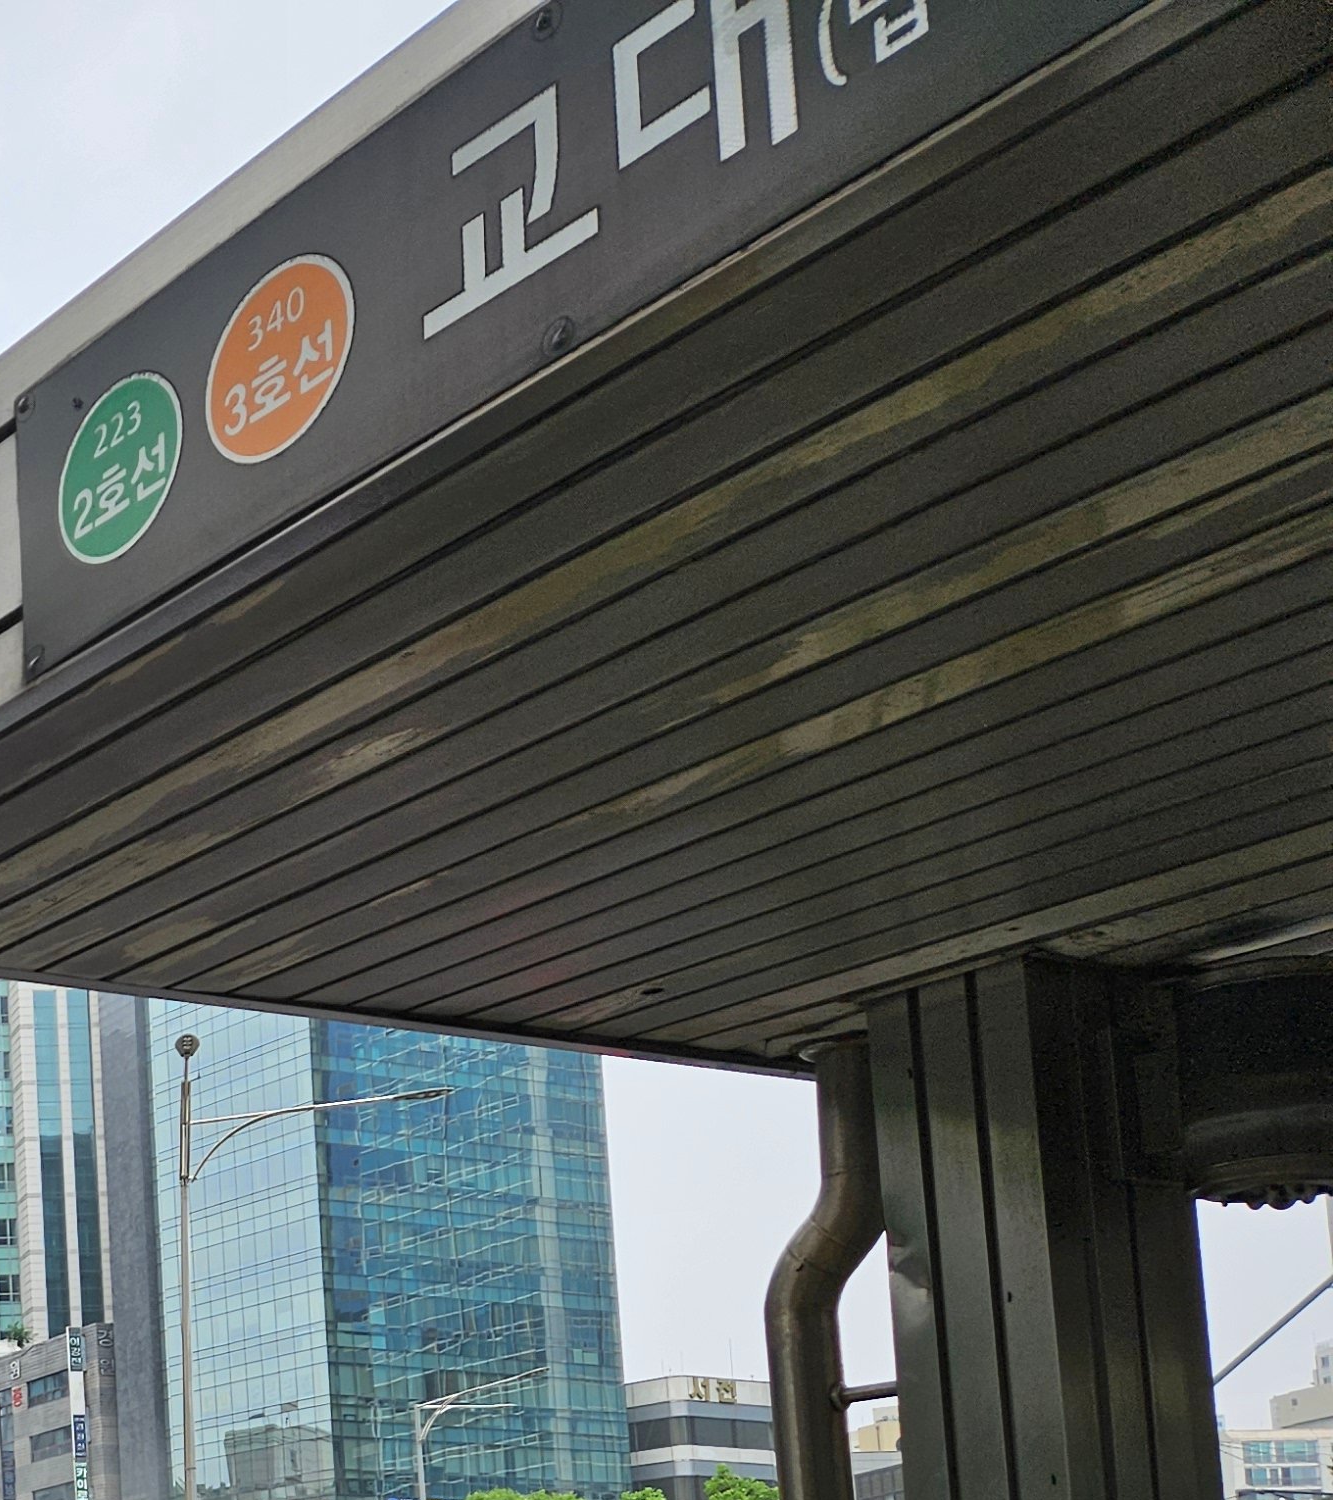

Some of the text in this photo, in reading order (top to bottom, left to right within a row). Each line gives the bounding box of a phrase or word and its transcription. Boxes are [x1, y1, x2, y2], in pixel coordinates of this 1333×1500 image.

[423, 0, 799, 340] 교대
[247, 285, 306, 352] 340
[93, 400, 143, 460] 223
[223, 318, 337, 440] 3호선
[73, 431, 169, 541] 2호선
